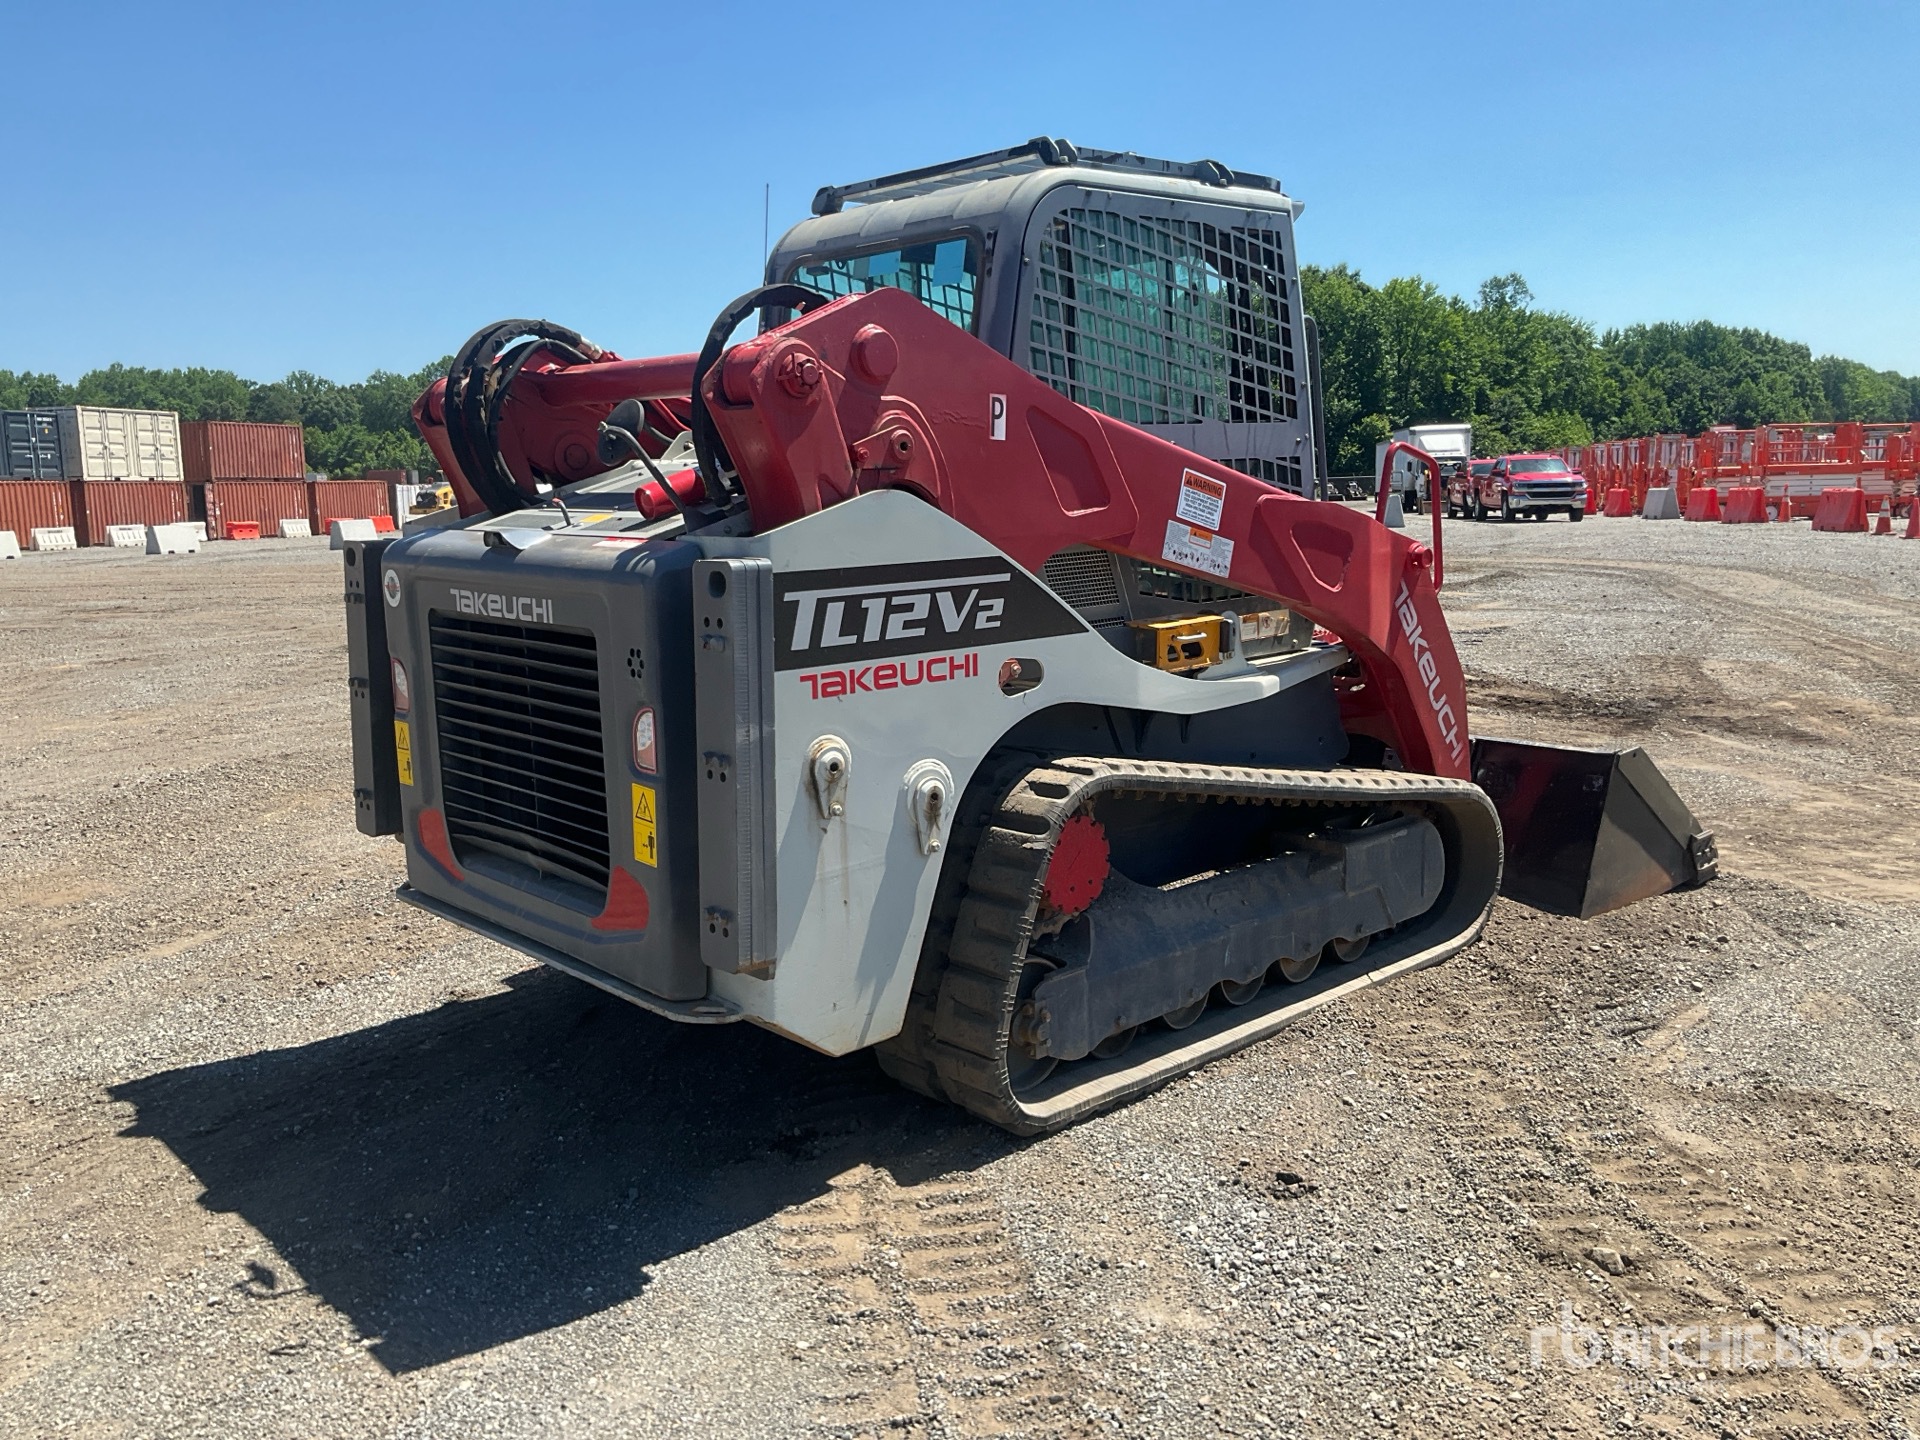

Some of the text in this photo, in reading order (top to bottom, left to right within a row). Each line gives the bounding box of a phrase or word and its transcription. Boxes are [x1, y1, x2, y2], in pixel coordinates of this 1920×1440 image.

[990, 396, 1005, 437] P
[1193, 477, 1223, 497] WARNING
[783, 572, 1011, 652] TL12V2
